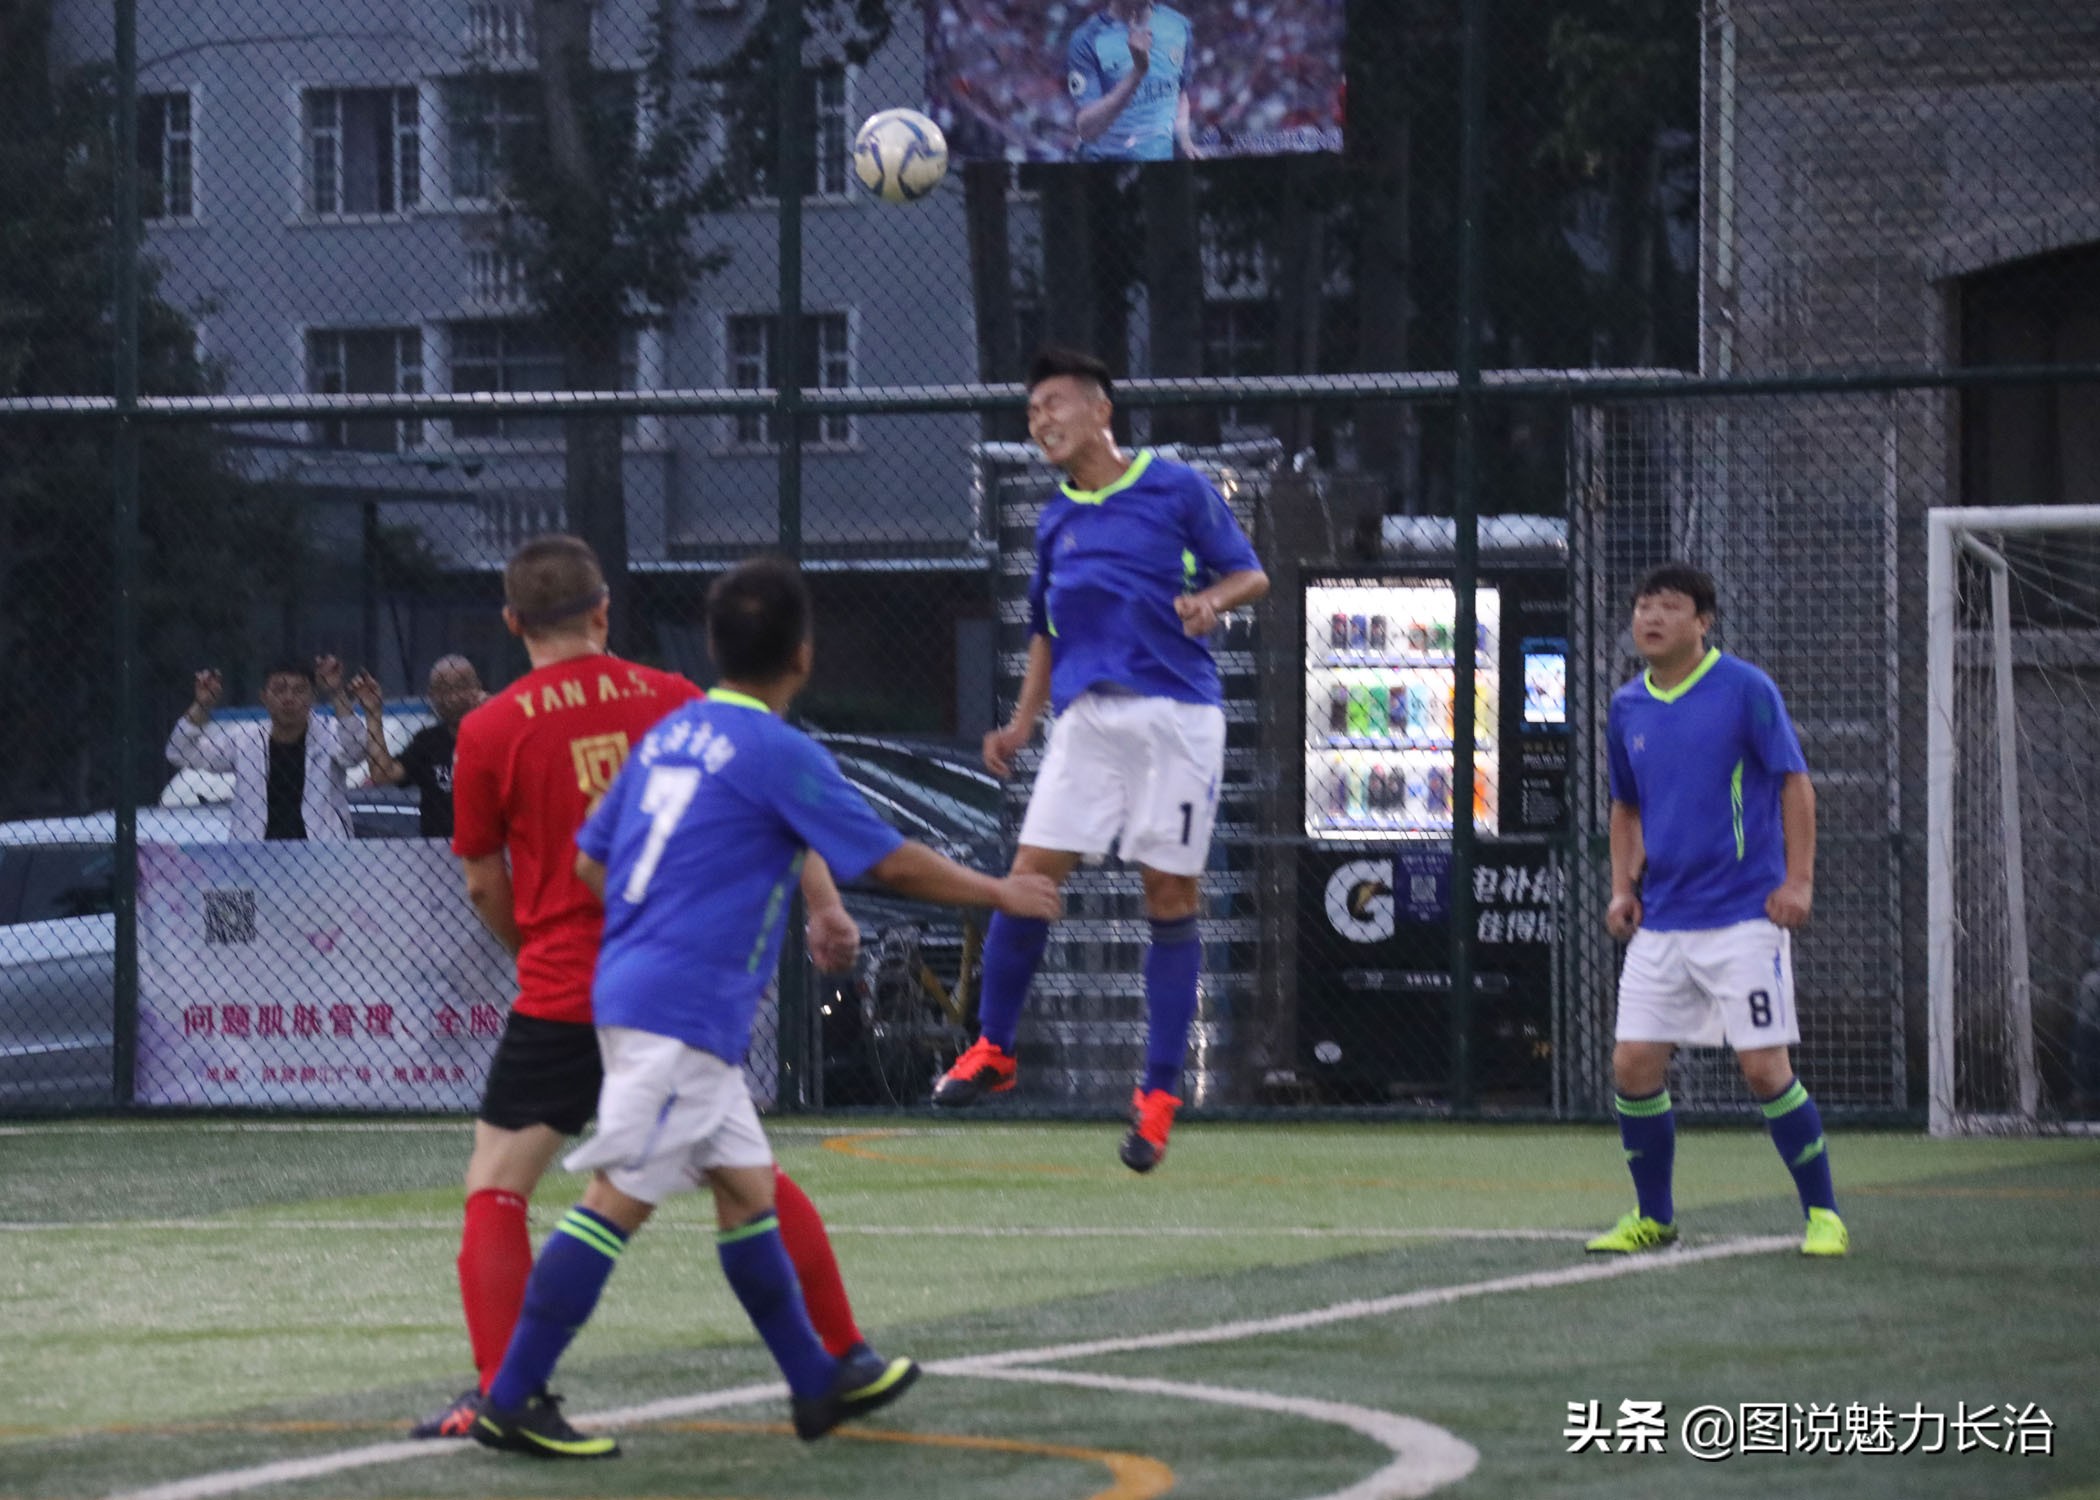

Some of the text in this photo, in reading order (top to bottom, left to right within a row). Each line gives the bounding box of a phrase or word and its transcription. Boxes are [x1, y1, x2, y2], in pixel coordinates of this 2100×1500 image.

[515, 679, 586, 718] YAN
[622, 764, 700, 904] 7
[1180, 802, 1192, 846] 1
[1749, 989, 1772, 1028] 8
